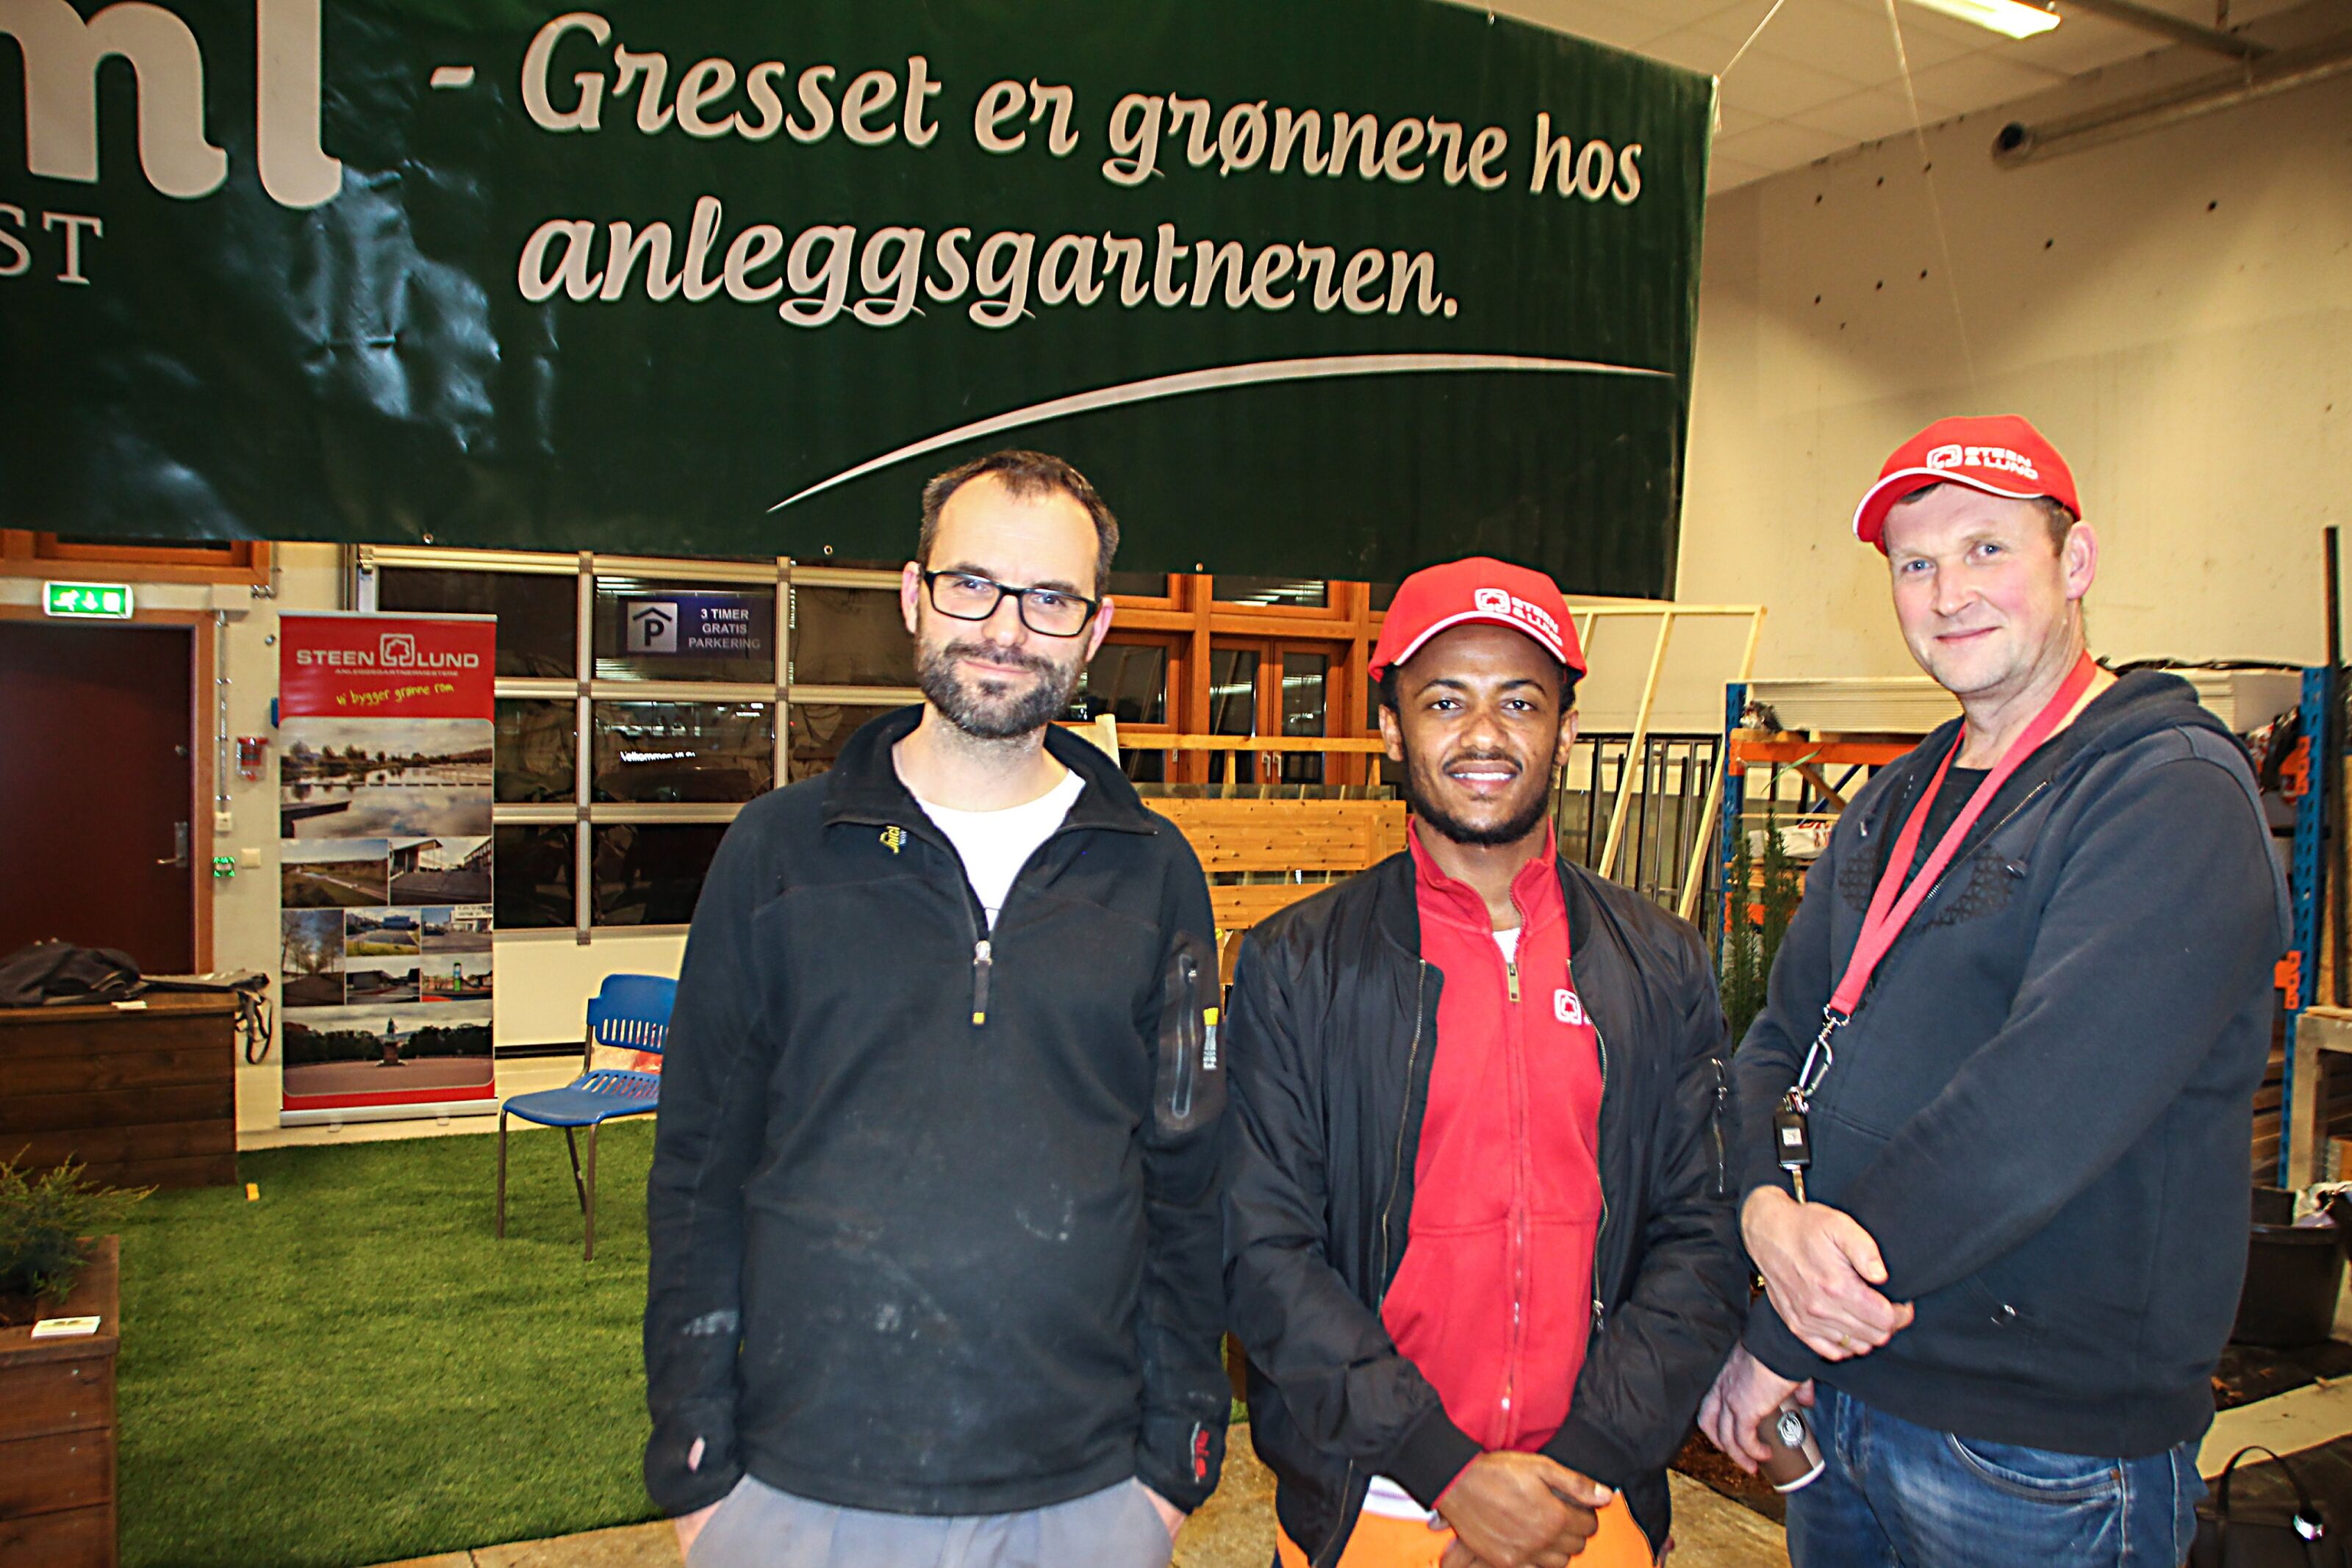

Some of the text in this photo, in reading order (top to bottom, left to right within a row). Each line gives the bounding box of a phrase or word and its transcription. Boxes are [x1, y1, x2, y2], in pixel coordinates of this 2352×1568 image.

[521, 12, 942, 146] Gresset
[975, 77, 1079, 156] er
[1102, 91, 1507, 190] grønnere
[1530, 112, 1643, 204] hos
[518, 196, 1458, 328] anleggsgartneren.
[1965, 447, 2032, 467] STEEN
[1983, 456, 2038, 480] LUND
[700, 608, 749, 619] 3 TIMER
[702, 622, 747, 634] GRATIS
[689, 636, 761, 648] PARKERING
[296, 650, 479, 668] STEEN LUND
[350, 689, 390, 705] bygger
[395, 685, 430, 702] grønne
